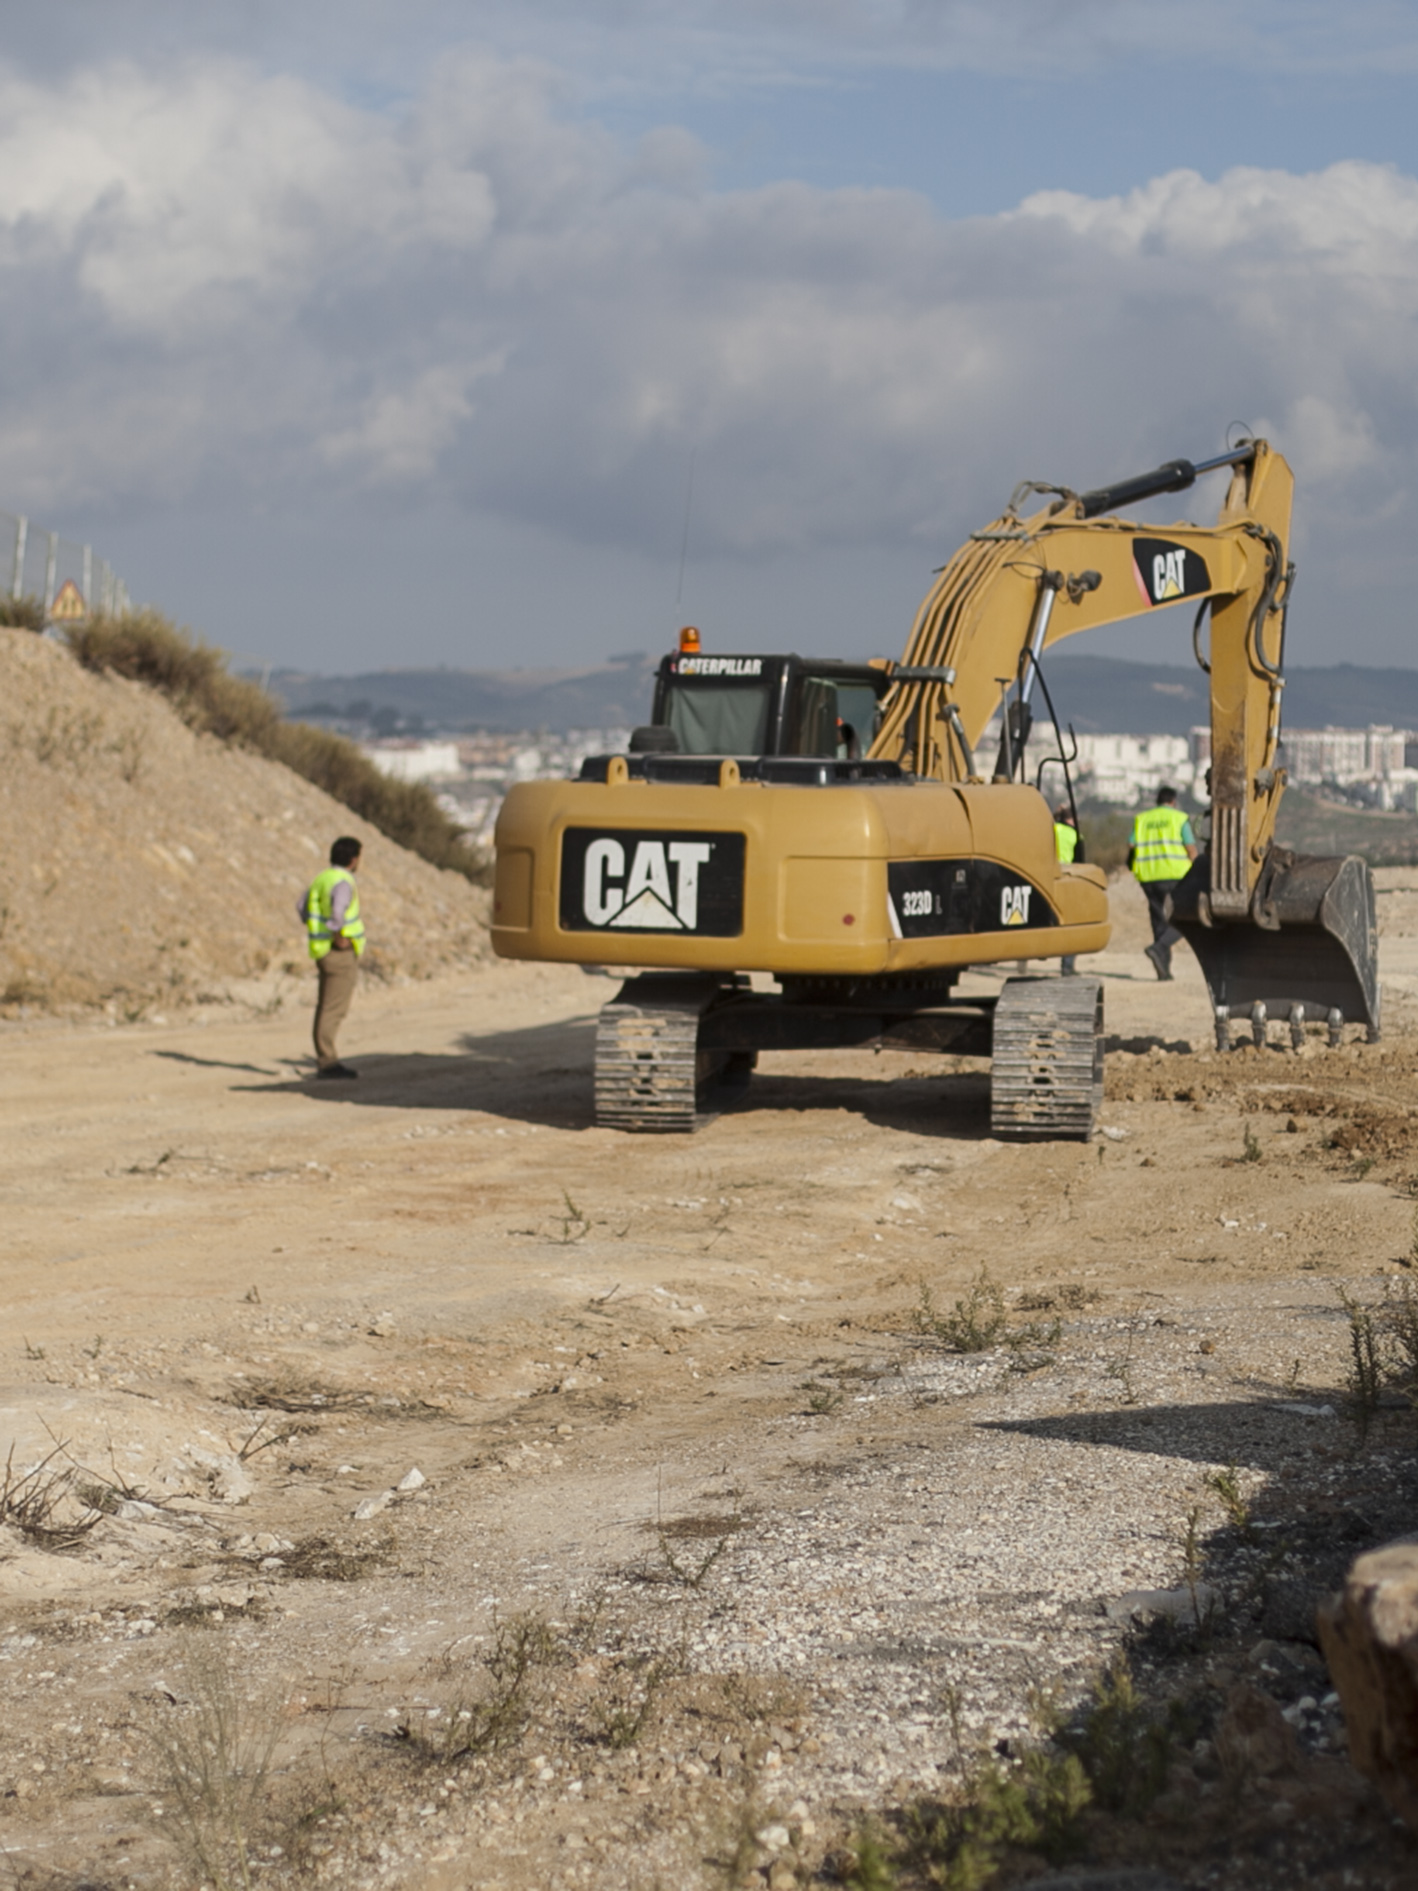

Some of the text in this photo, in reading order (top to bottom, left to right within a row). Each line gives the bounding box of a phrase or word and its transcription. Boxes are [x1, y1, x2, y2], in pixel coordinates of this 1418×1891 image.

[1153, 549, 1185, 600] CAT
[678, 658, 762, 675] CATERPILLAR
[583, 838, 711, 930] CAT
[903, 891, 932, 916] 323D
[1001, 886, 1032, 925] CAT
